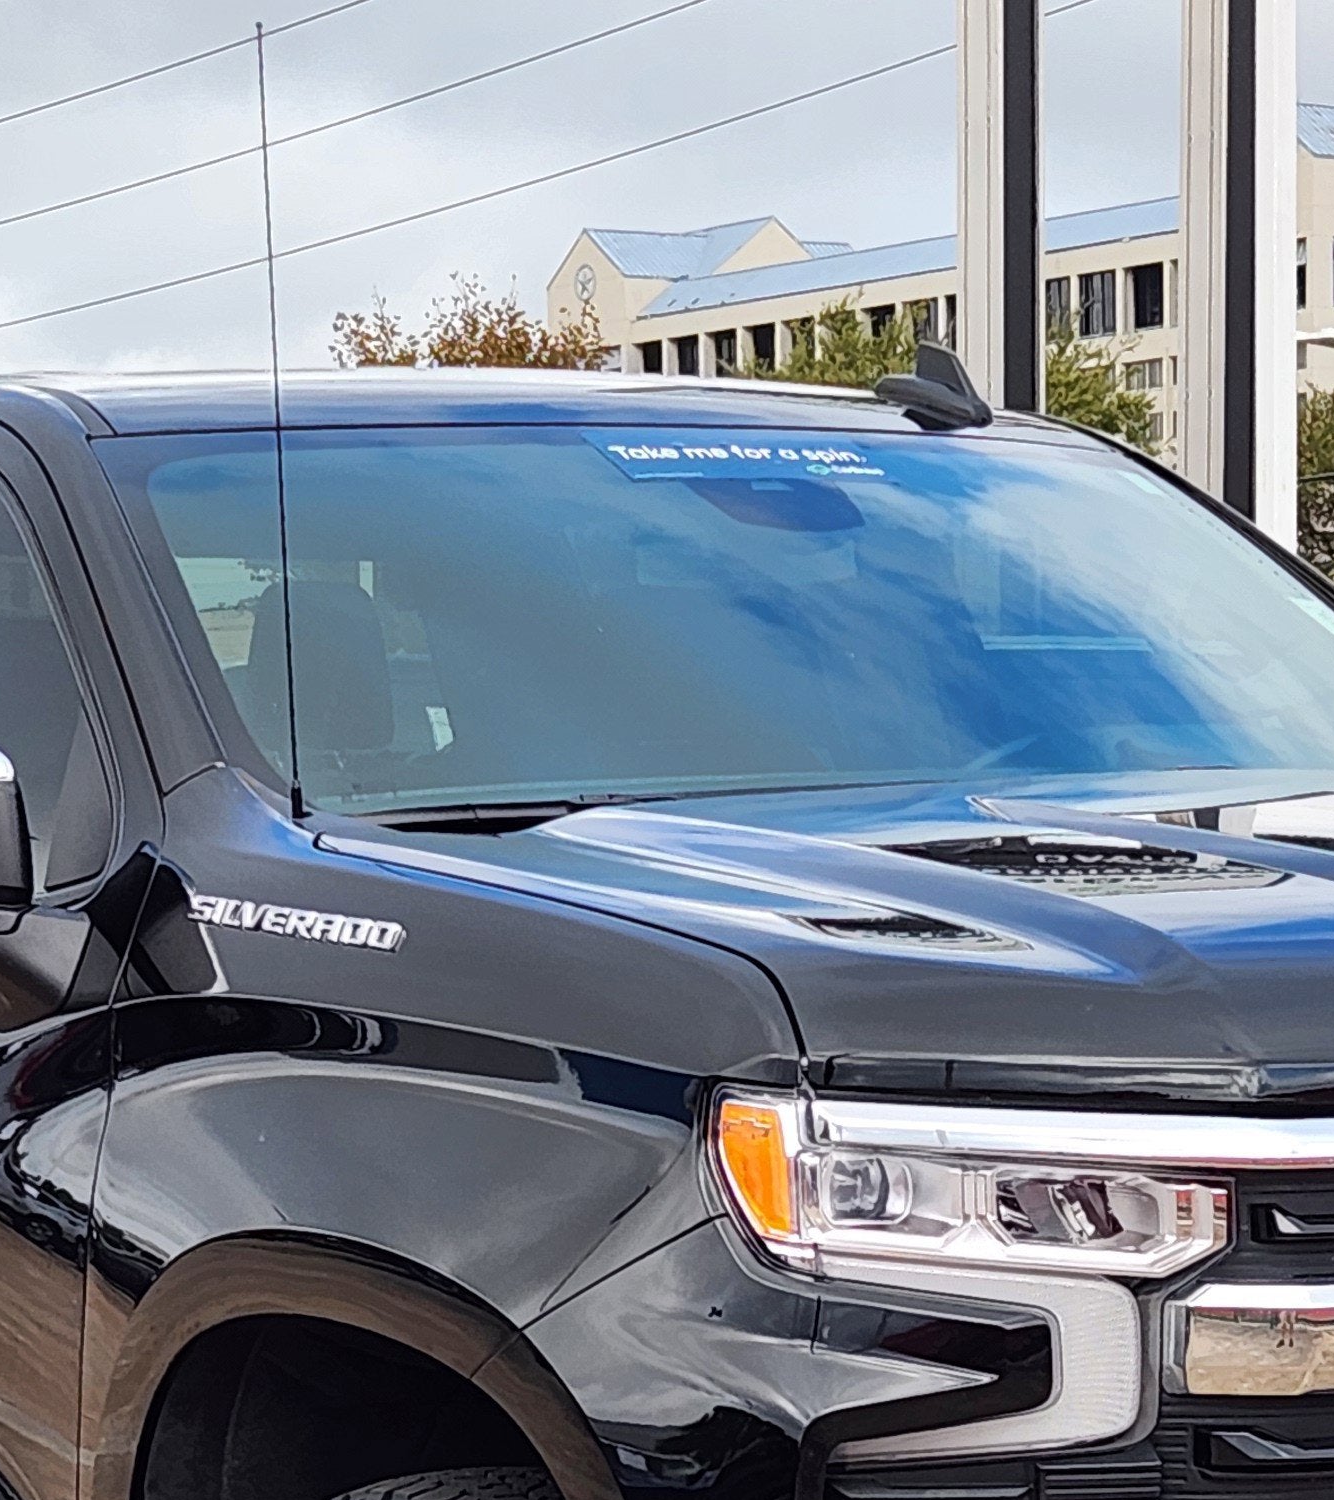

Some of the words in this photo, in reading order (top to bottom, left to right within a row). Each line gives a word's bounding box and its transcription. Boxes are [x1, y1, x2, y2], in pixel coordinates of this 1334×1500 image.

[608, 445, 679, 461] Take
[682, 446, 729, 461] me
[730, 445, 772, 460] for
[778, 448, 800, 461] a
[188, 894, 407, 952] SILVERADO
